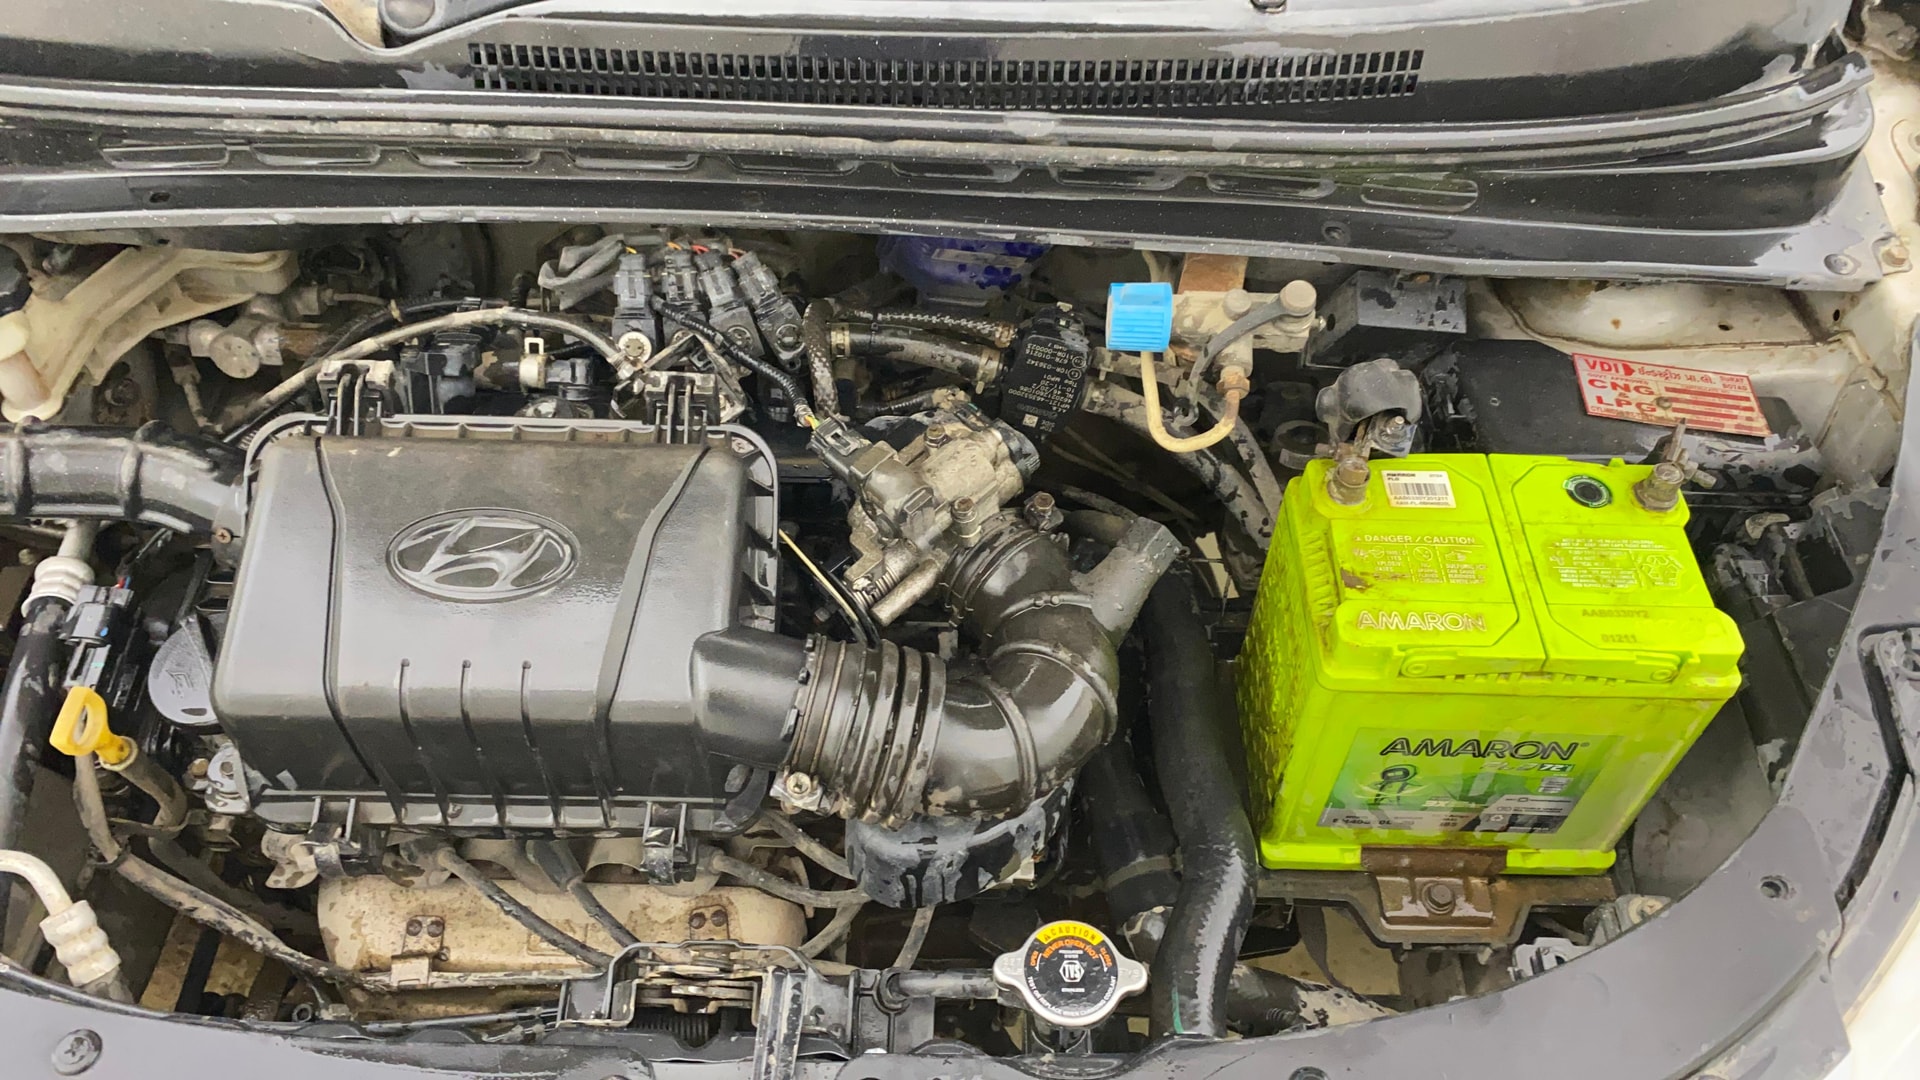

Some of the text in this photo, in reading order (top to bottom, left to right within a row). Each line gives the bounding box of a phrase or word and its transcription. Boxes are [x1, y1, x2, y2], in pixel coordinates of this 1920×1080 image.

[1584, 359, 1620, 374] VDI
[1588, 379, 1655, 395] CNG
[1595, 395, 1657, 412] LPG
[1364, 535, 1412, 543] DANGER
[1423, 535, 1475, 544] CAUTION
[1358, 610, 1487, 632] AMARON
[1380, 737, 1580, 761] AMARON
[1051, 926, 1097, 941] CAUTION
[1064, 963, 1081, 979] TVS
[1028, 976, 1037, 990] TEST
